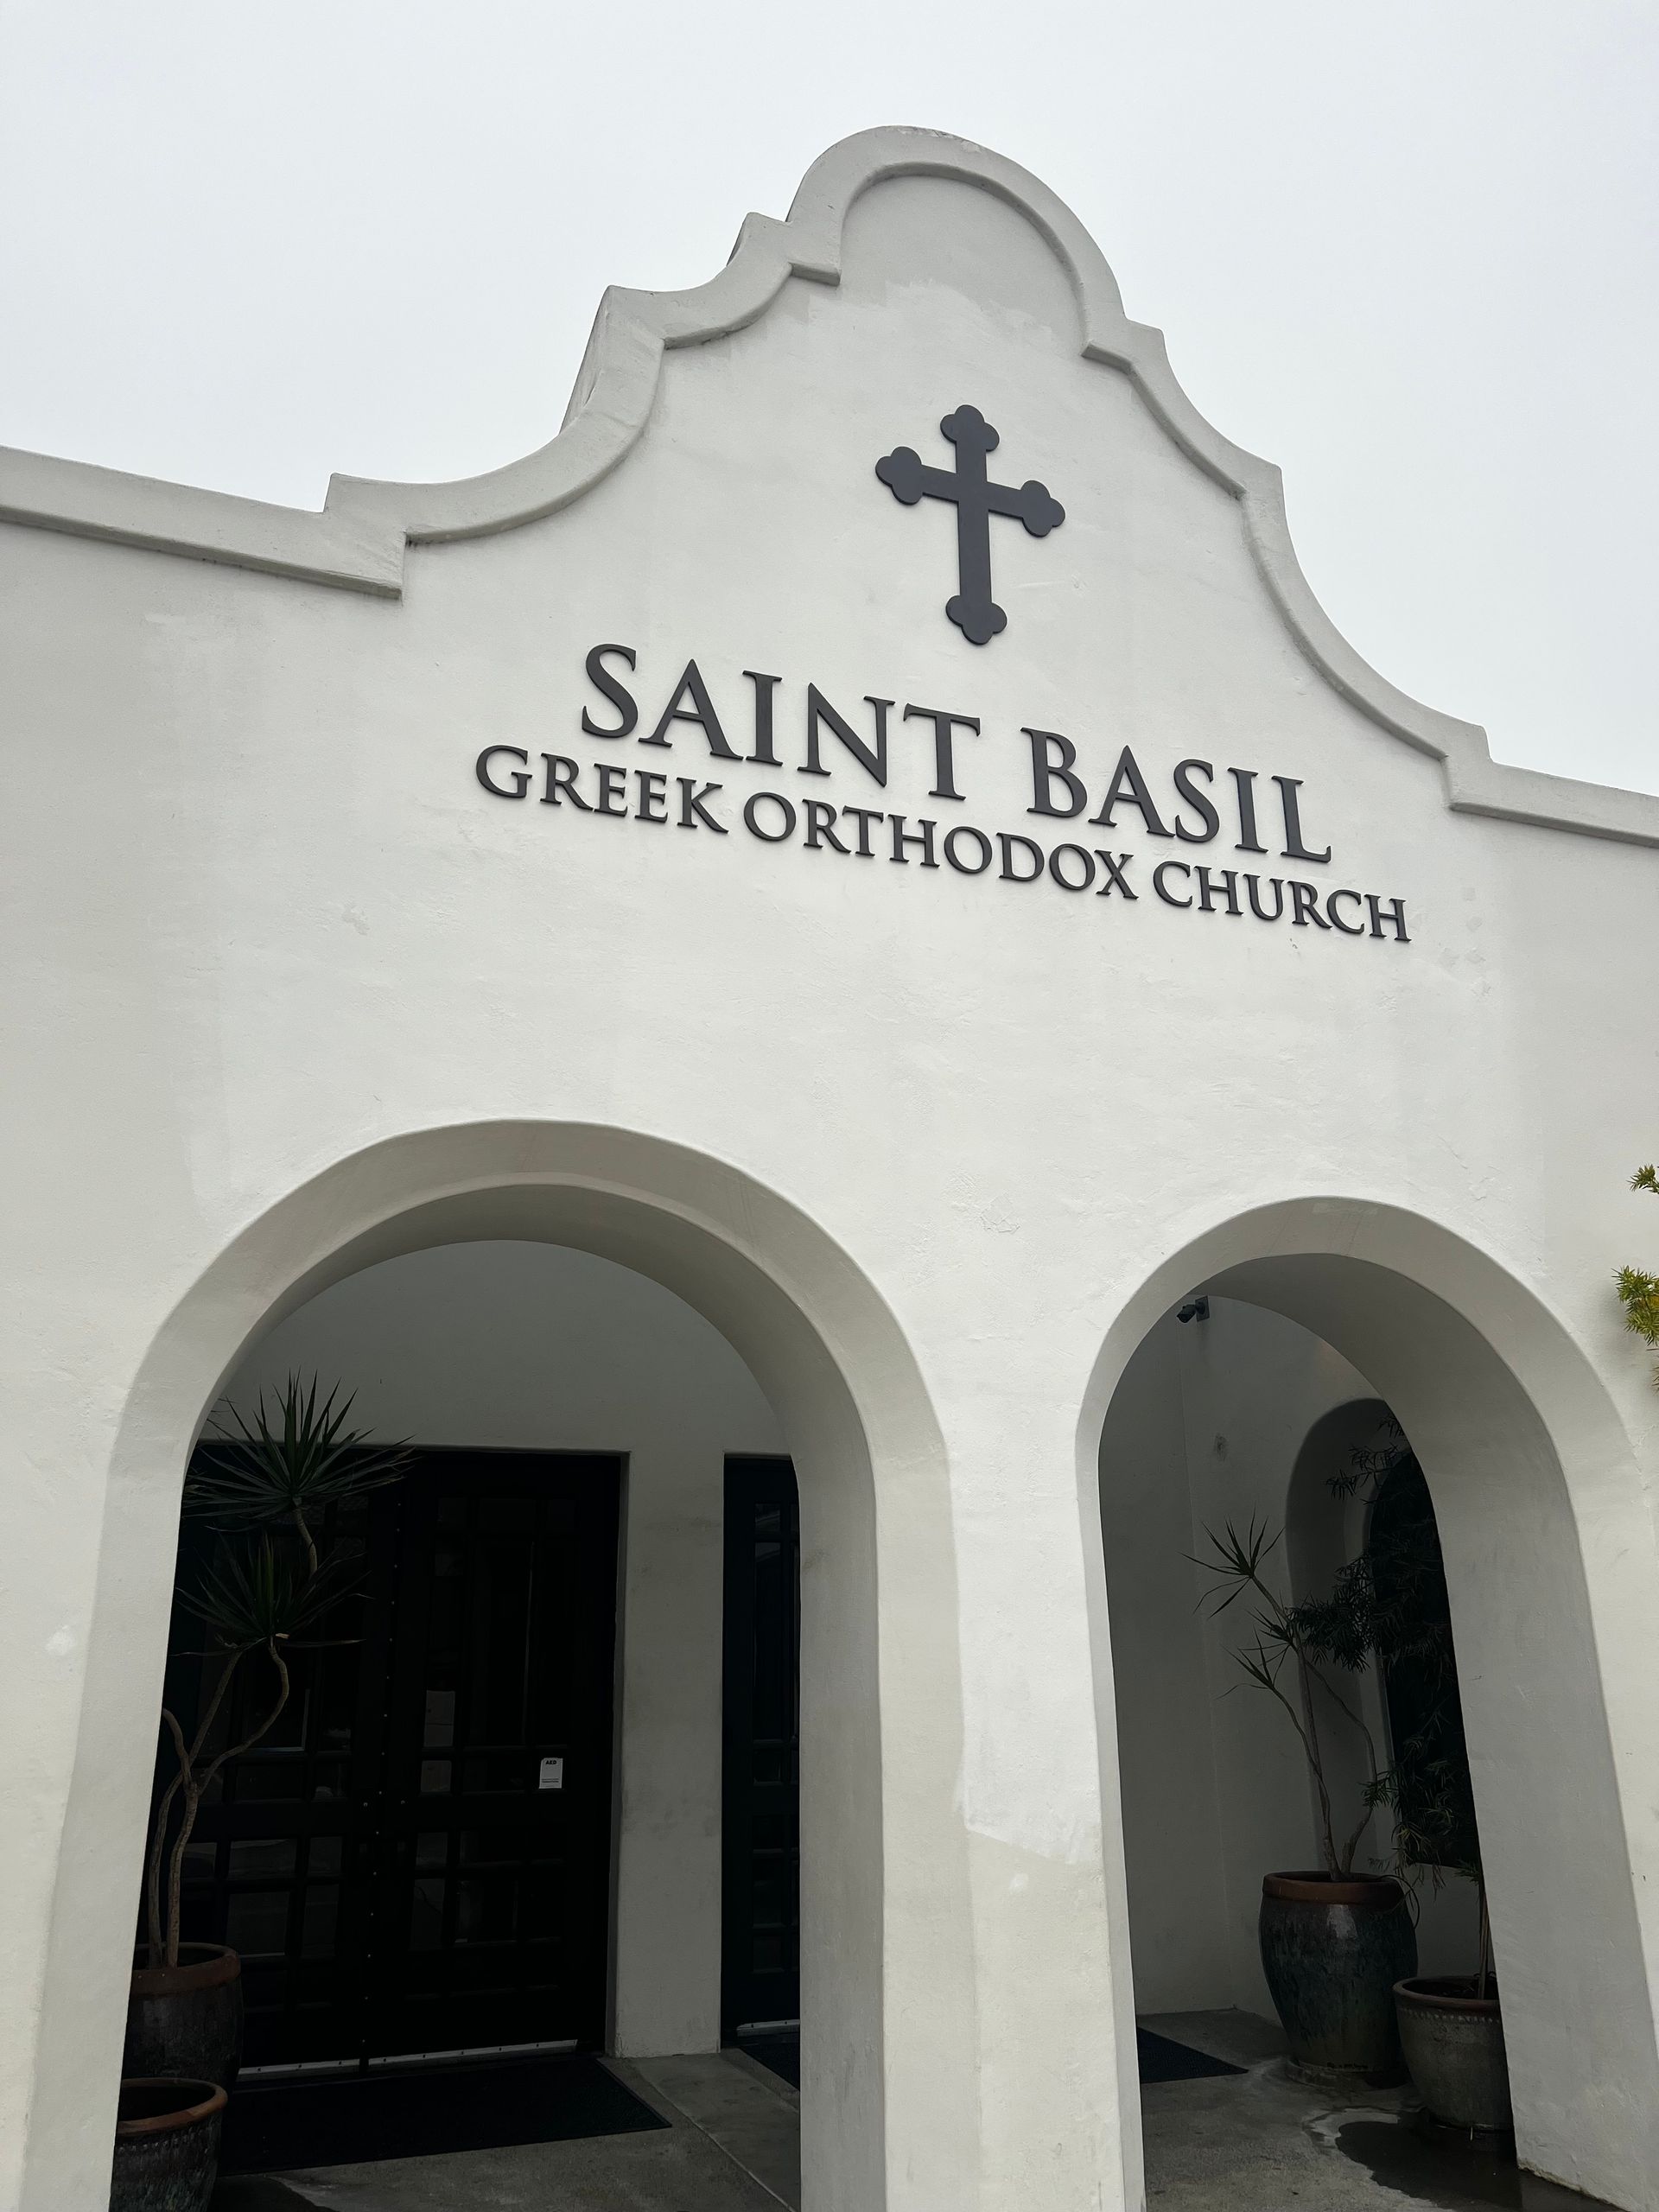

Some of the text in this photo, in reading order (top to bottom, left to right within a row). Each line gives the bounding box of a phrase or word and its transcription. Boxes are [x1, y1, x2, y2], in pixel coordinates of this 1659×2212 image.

[475, 744, 1411, 944] GREEK ORTHODOX CHURCH
[582, 644, 1332, 863] SAINT BASIL
